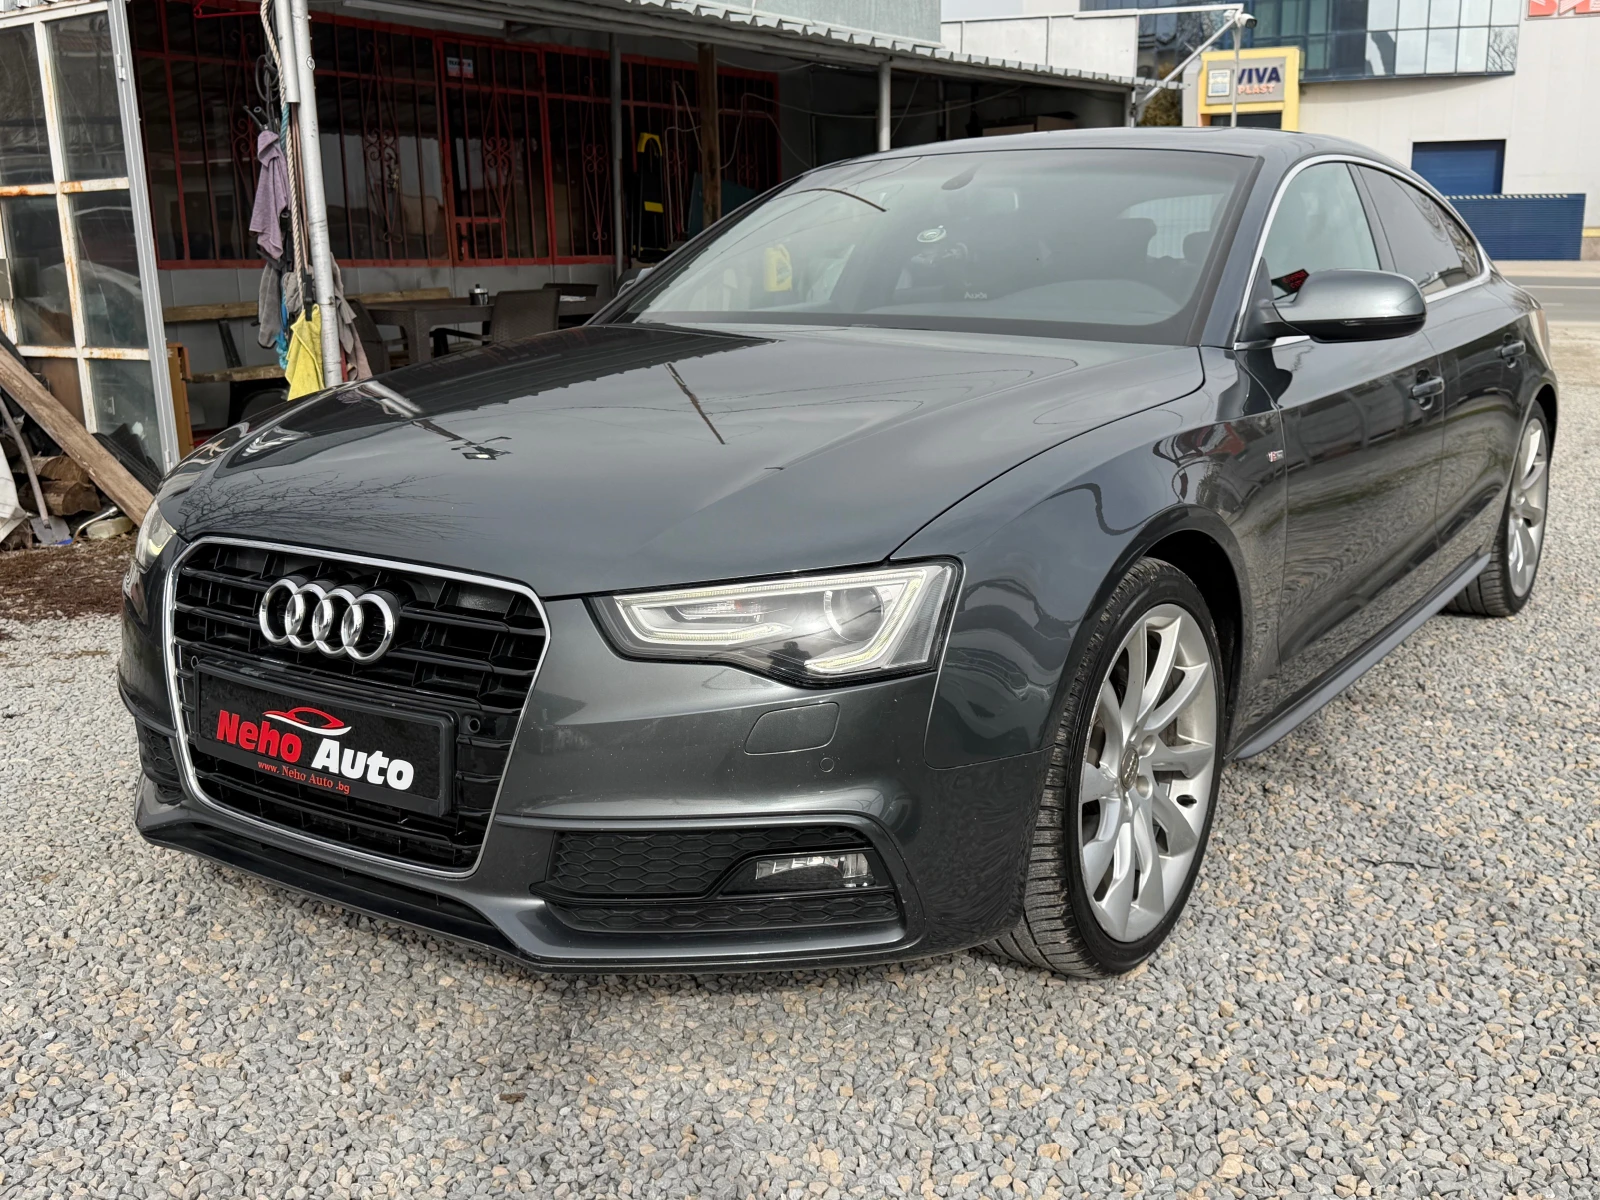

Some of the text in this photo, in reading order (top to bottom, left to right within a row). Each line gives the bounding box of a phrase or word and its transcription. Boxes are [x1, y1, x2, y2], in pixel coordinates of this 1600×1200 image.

[1232, 67, 1281, 84] VIVA
[1237, 84, 1275, 95] PLAST
[216, 709, 415, 791] Neho Auto
[257, 761, 350, 795] www. Neho Auto .bg
